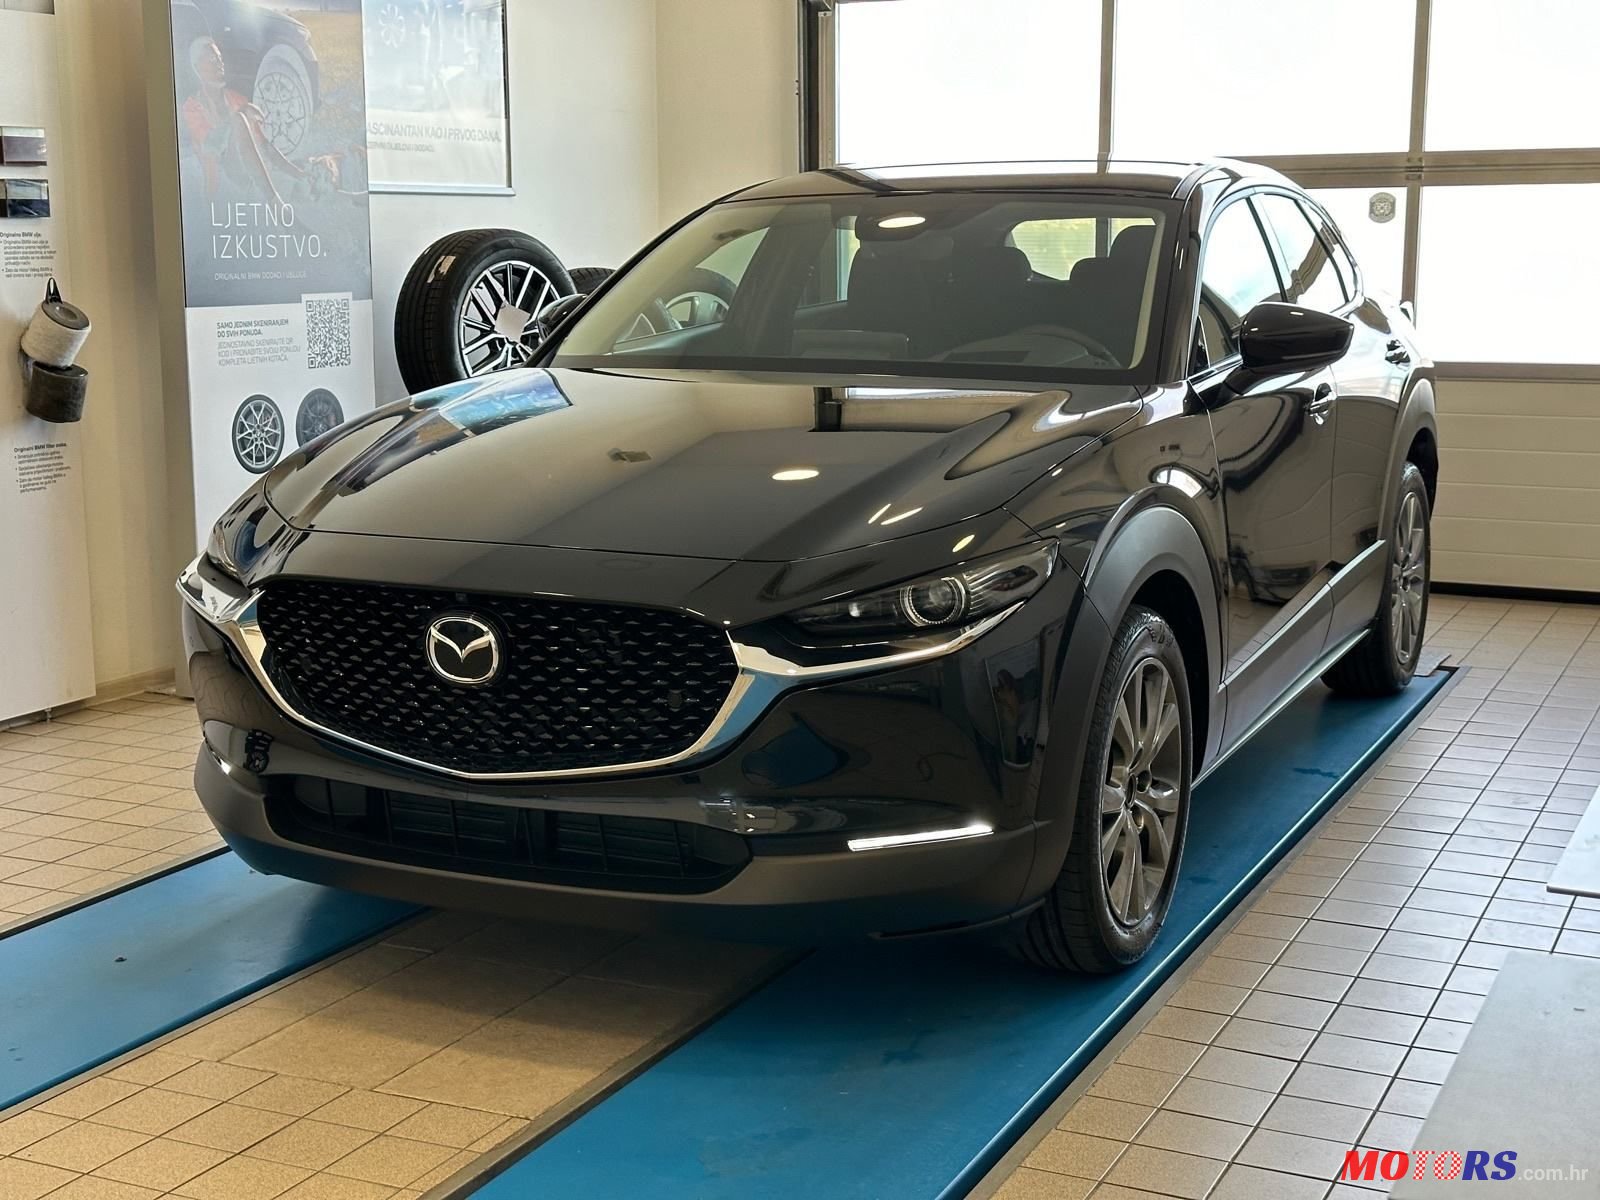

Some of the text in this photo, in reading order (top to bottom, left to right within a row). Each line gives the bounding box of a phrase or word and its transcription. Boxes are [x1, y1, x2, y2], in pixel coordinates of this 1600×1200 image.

[425, 125, 441, 138] KAO
[448, 127, 476, 141] PRVOG
[211, 202, 294, 228] LJETNO
[212, 234, 327, 259] IZKUSTVO.
[234, 320, 252, 328] JEDNIM
[254, 318, 288, 327] SKENIRANJEM
[226, 330, 239, 338] SVIH
